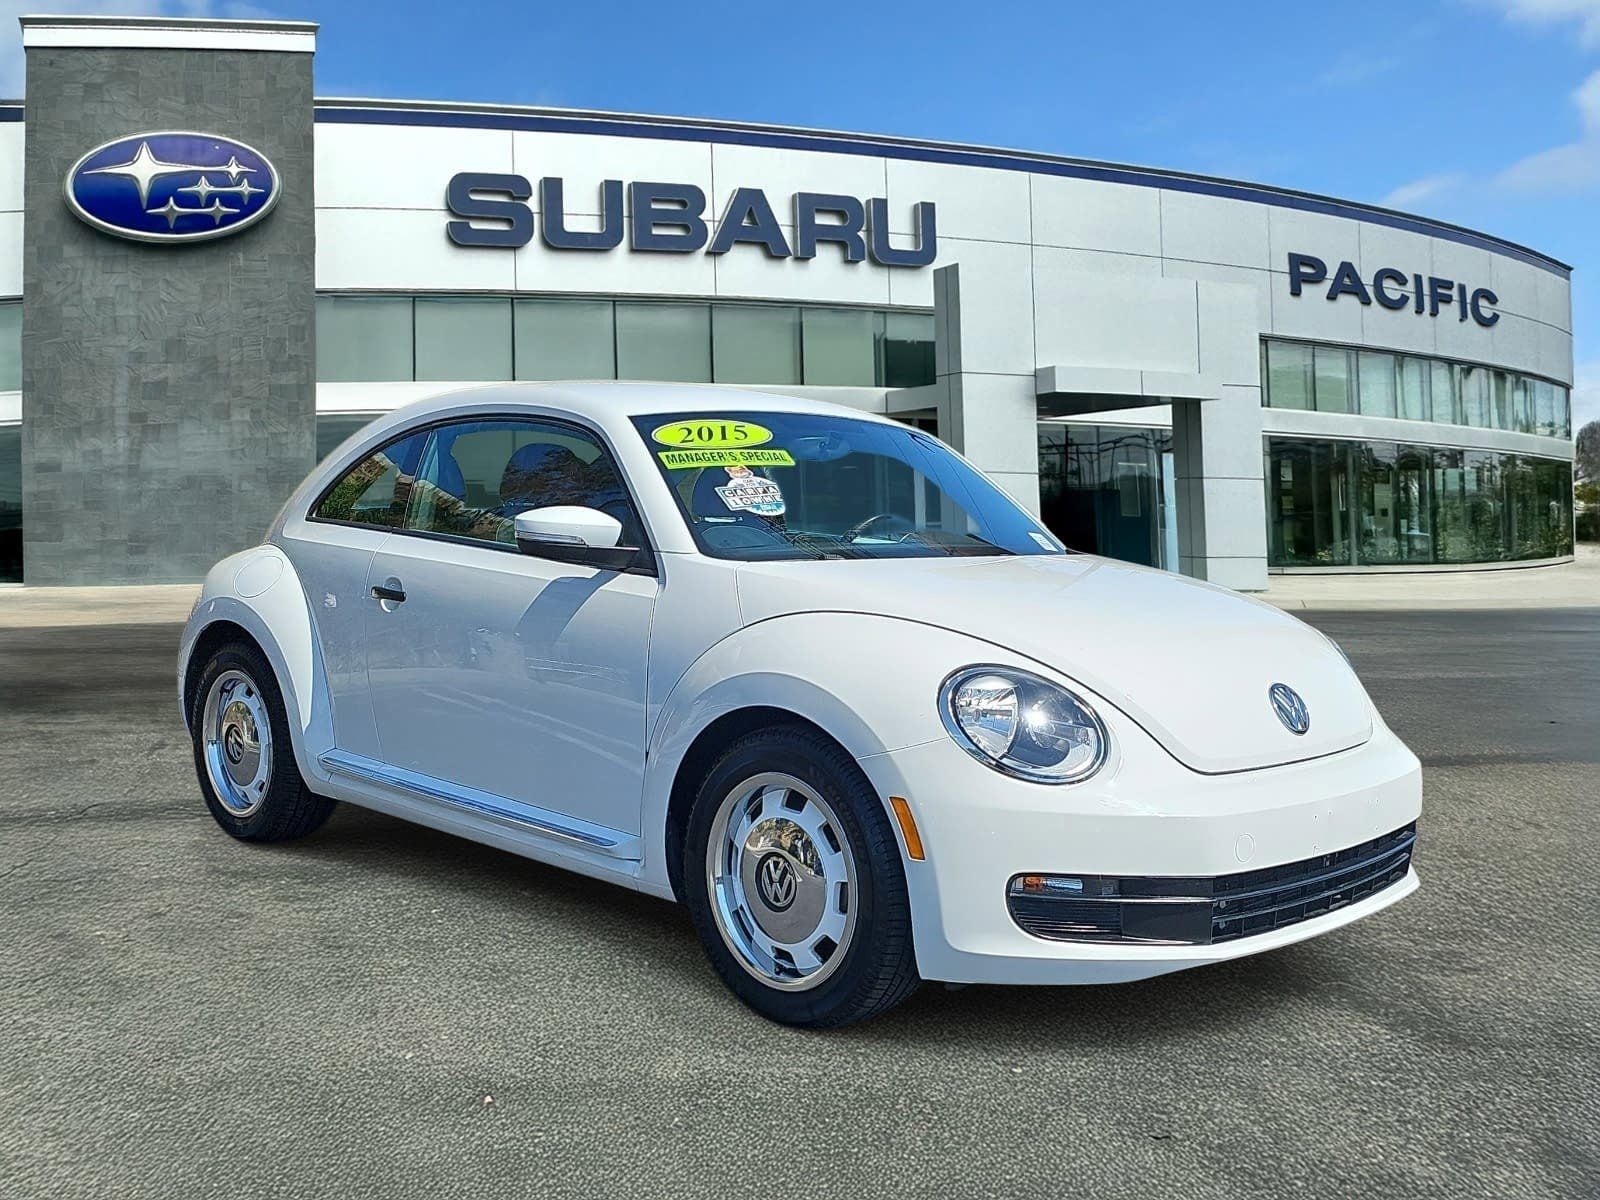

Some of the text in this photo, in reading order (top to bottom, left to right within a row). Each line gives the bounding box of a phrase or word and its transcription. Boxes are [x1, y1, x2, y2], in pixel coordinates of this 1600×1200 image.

[446, 171, 937, 268] SUBARU
[1287, 251, 1501, 328] PACIFIC
[679, 425, 748, 443] 2015
[665, 451, 787, 465] MANAGER'S SPECIAL
